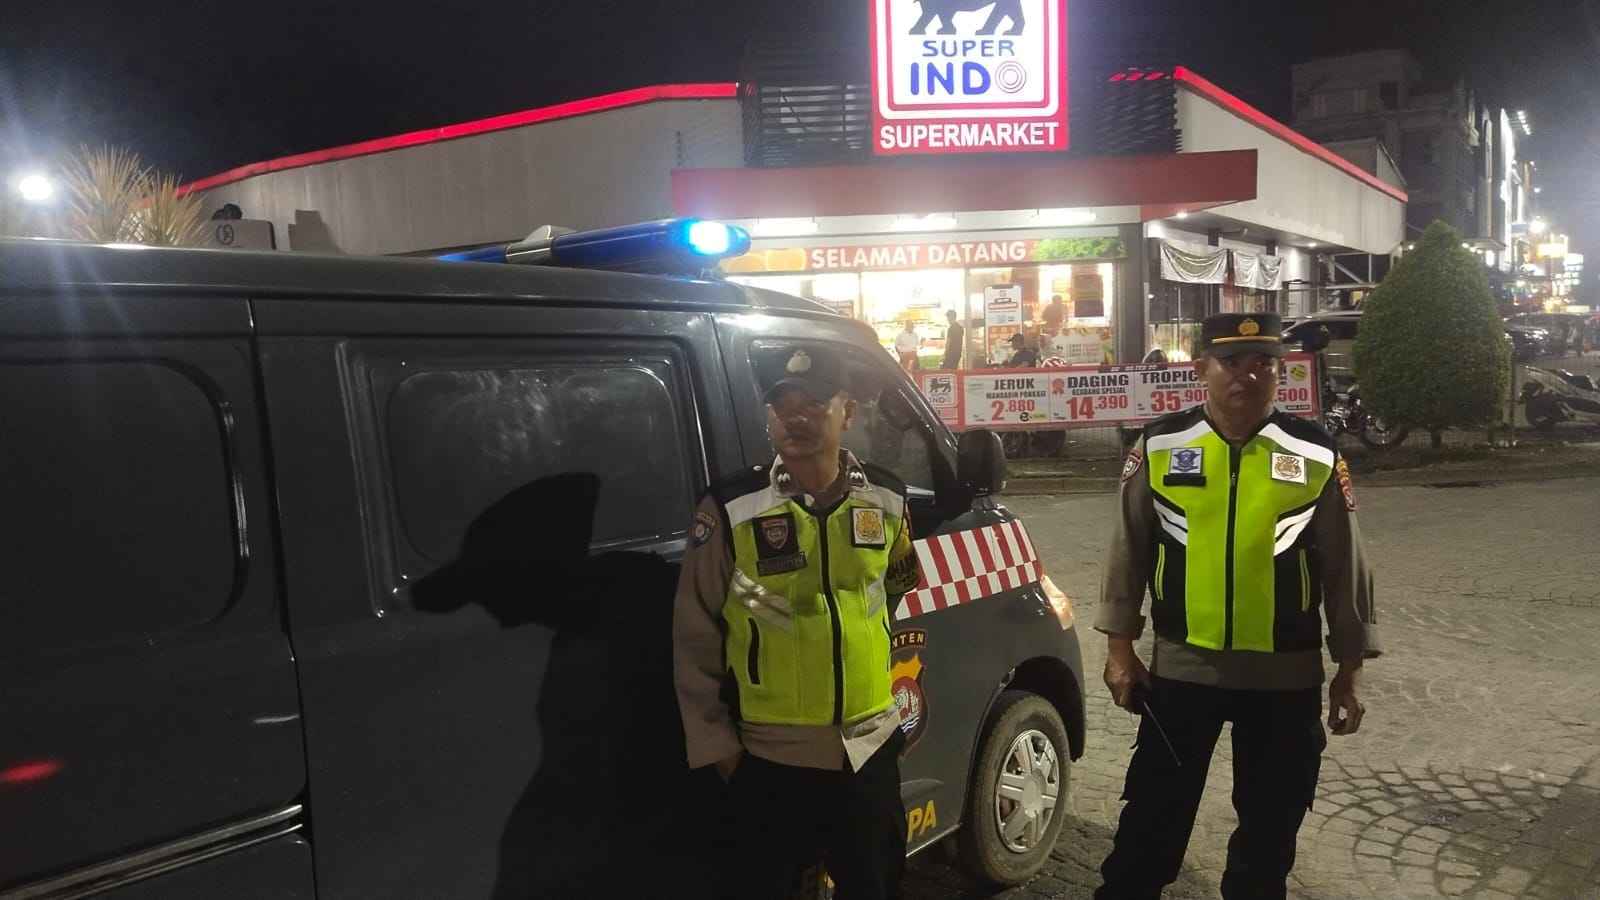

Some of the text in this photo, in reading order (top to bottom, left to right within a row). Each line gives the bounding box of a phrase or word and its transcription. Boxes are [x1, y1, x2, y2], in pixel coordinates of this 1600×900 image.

[922, 40, 1015, 57] SUPER
[880, 122, 1059, 149] SUPERMARKET
[811, 241, 1026, 269] SELAMAT DATANG
[994, 378, 1034, 391] JERUK
[1068, 374, 1129, 388] DAGING
